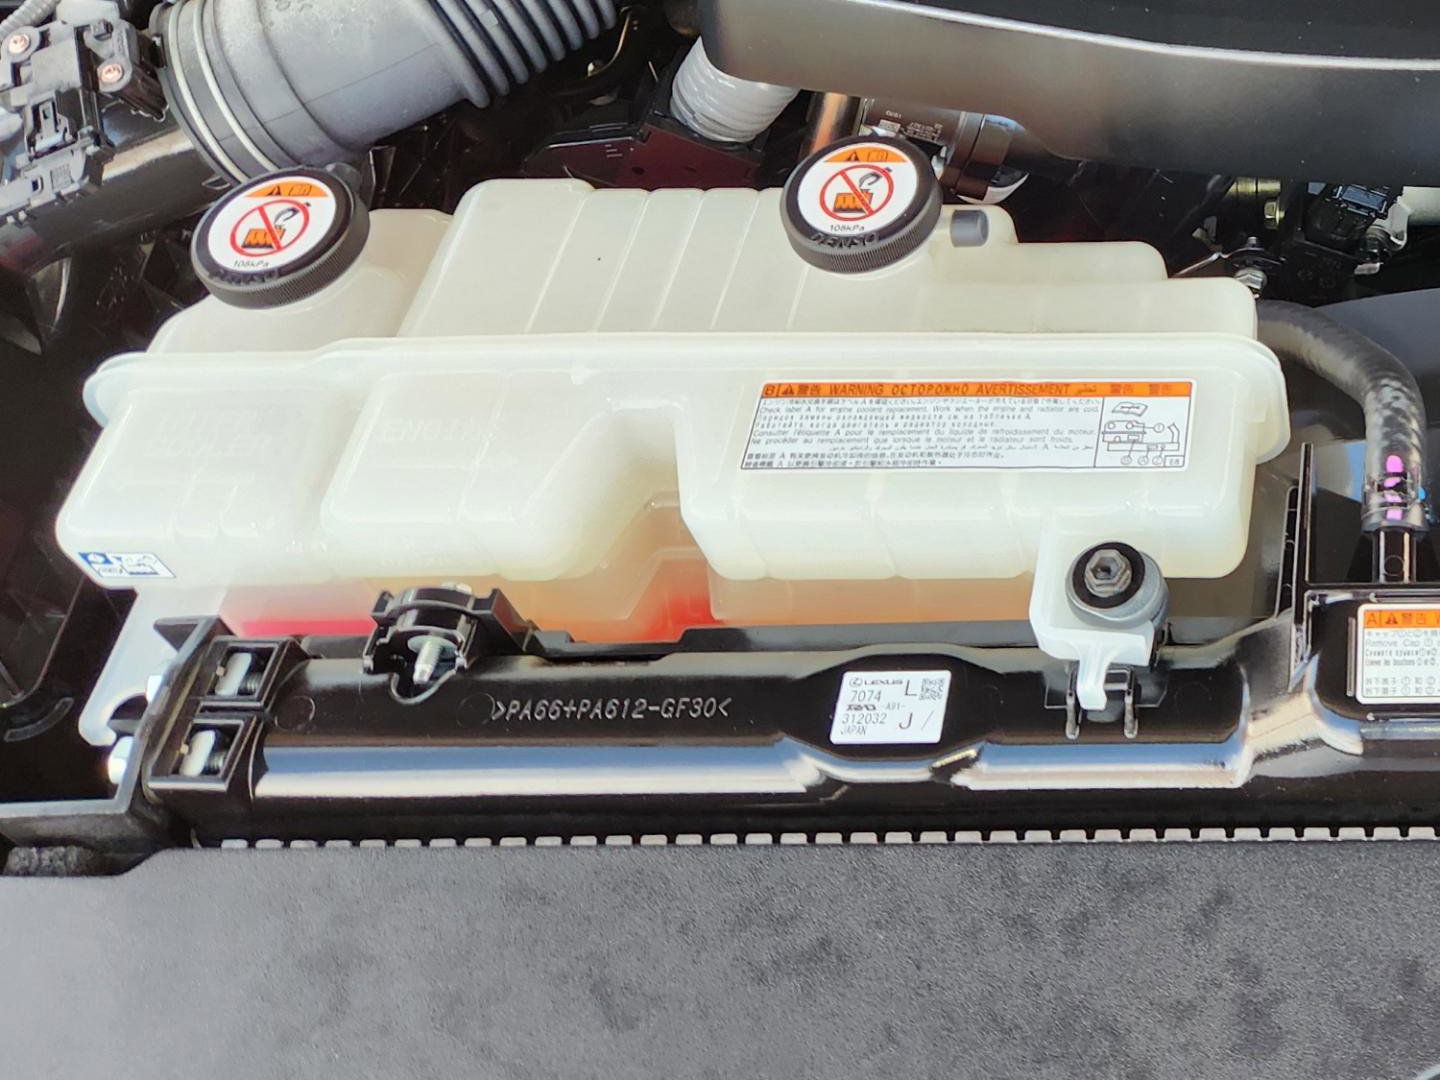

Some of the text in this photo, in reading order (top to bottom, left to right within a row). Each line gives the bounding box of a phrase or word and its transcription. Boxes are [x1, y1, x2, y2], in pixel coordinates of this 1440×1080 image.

[765, 385, 775, 395] B
[829, 384, 884, 395] WARNING
[977, 384, 1071, 395] AVERTISSEMENT
[1366, 612, 1377, 624] A
[905, 680, 917, 696] L
[850, 689, 882, 702] 7074
[492, 697, 732, 720] >PA66+PA612-GF30<
[841, 712, 888, 725] 312032
[899, 712, 913, 730] J
